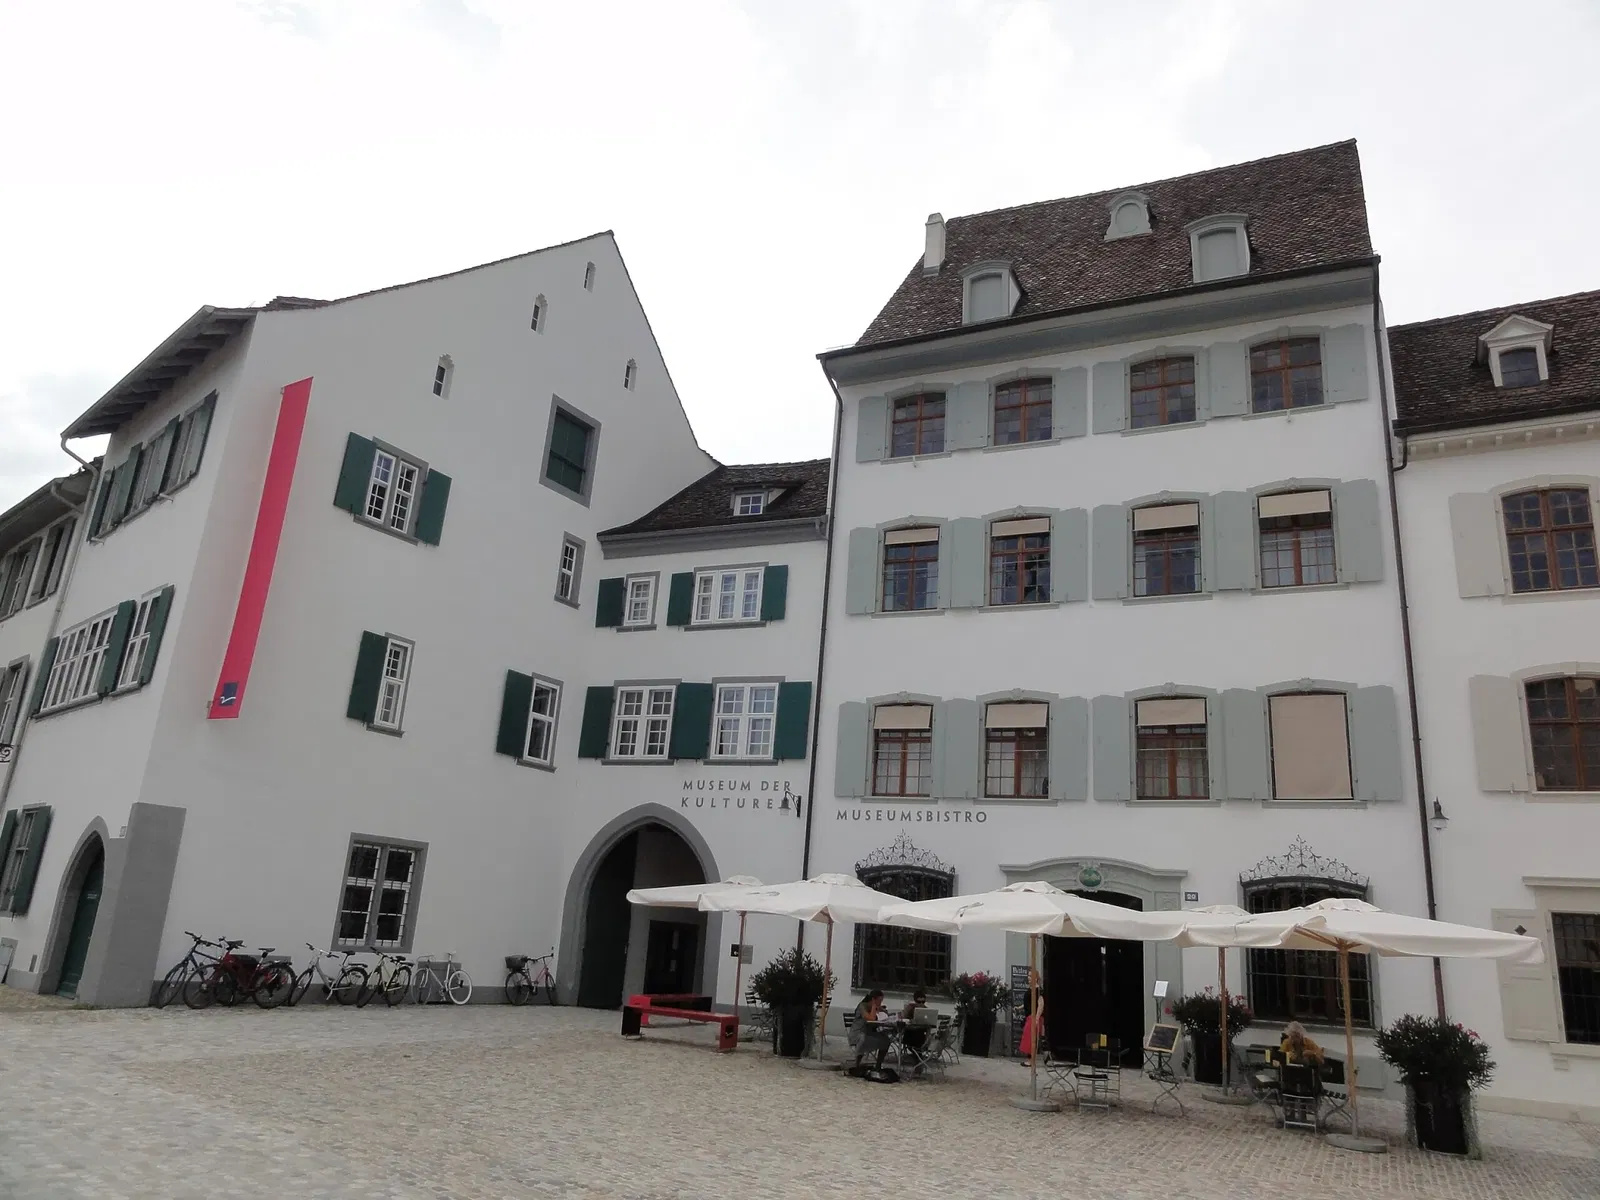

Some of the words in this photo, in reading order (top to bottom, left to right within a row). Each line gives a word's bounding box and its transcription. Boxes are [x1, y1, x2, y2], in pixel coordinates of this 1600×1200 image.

[682, 780, 752, 791] MUSEUM
[760, 780, 791, 792] DER
[681, 797, 788, 809] KULTURE
[836, 809, 987, 823] MUSEUMSBISTRO
